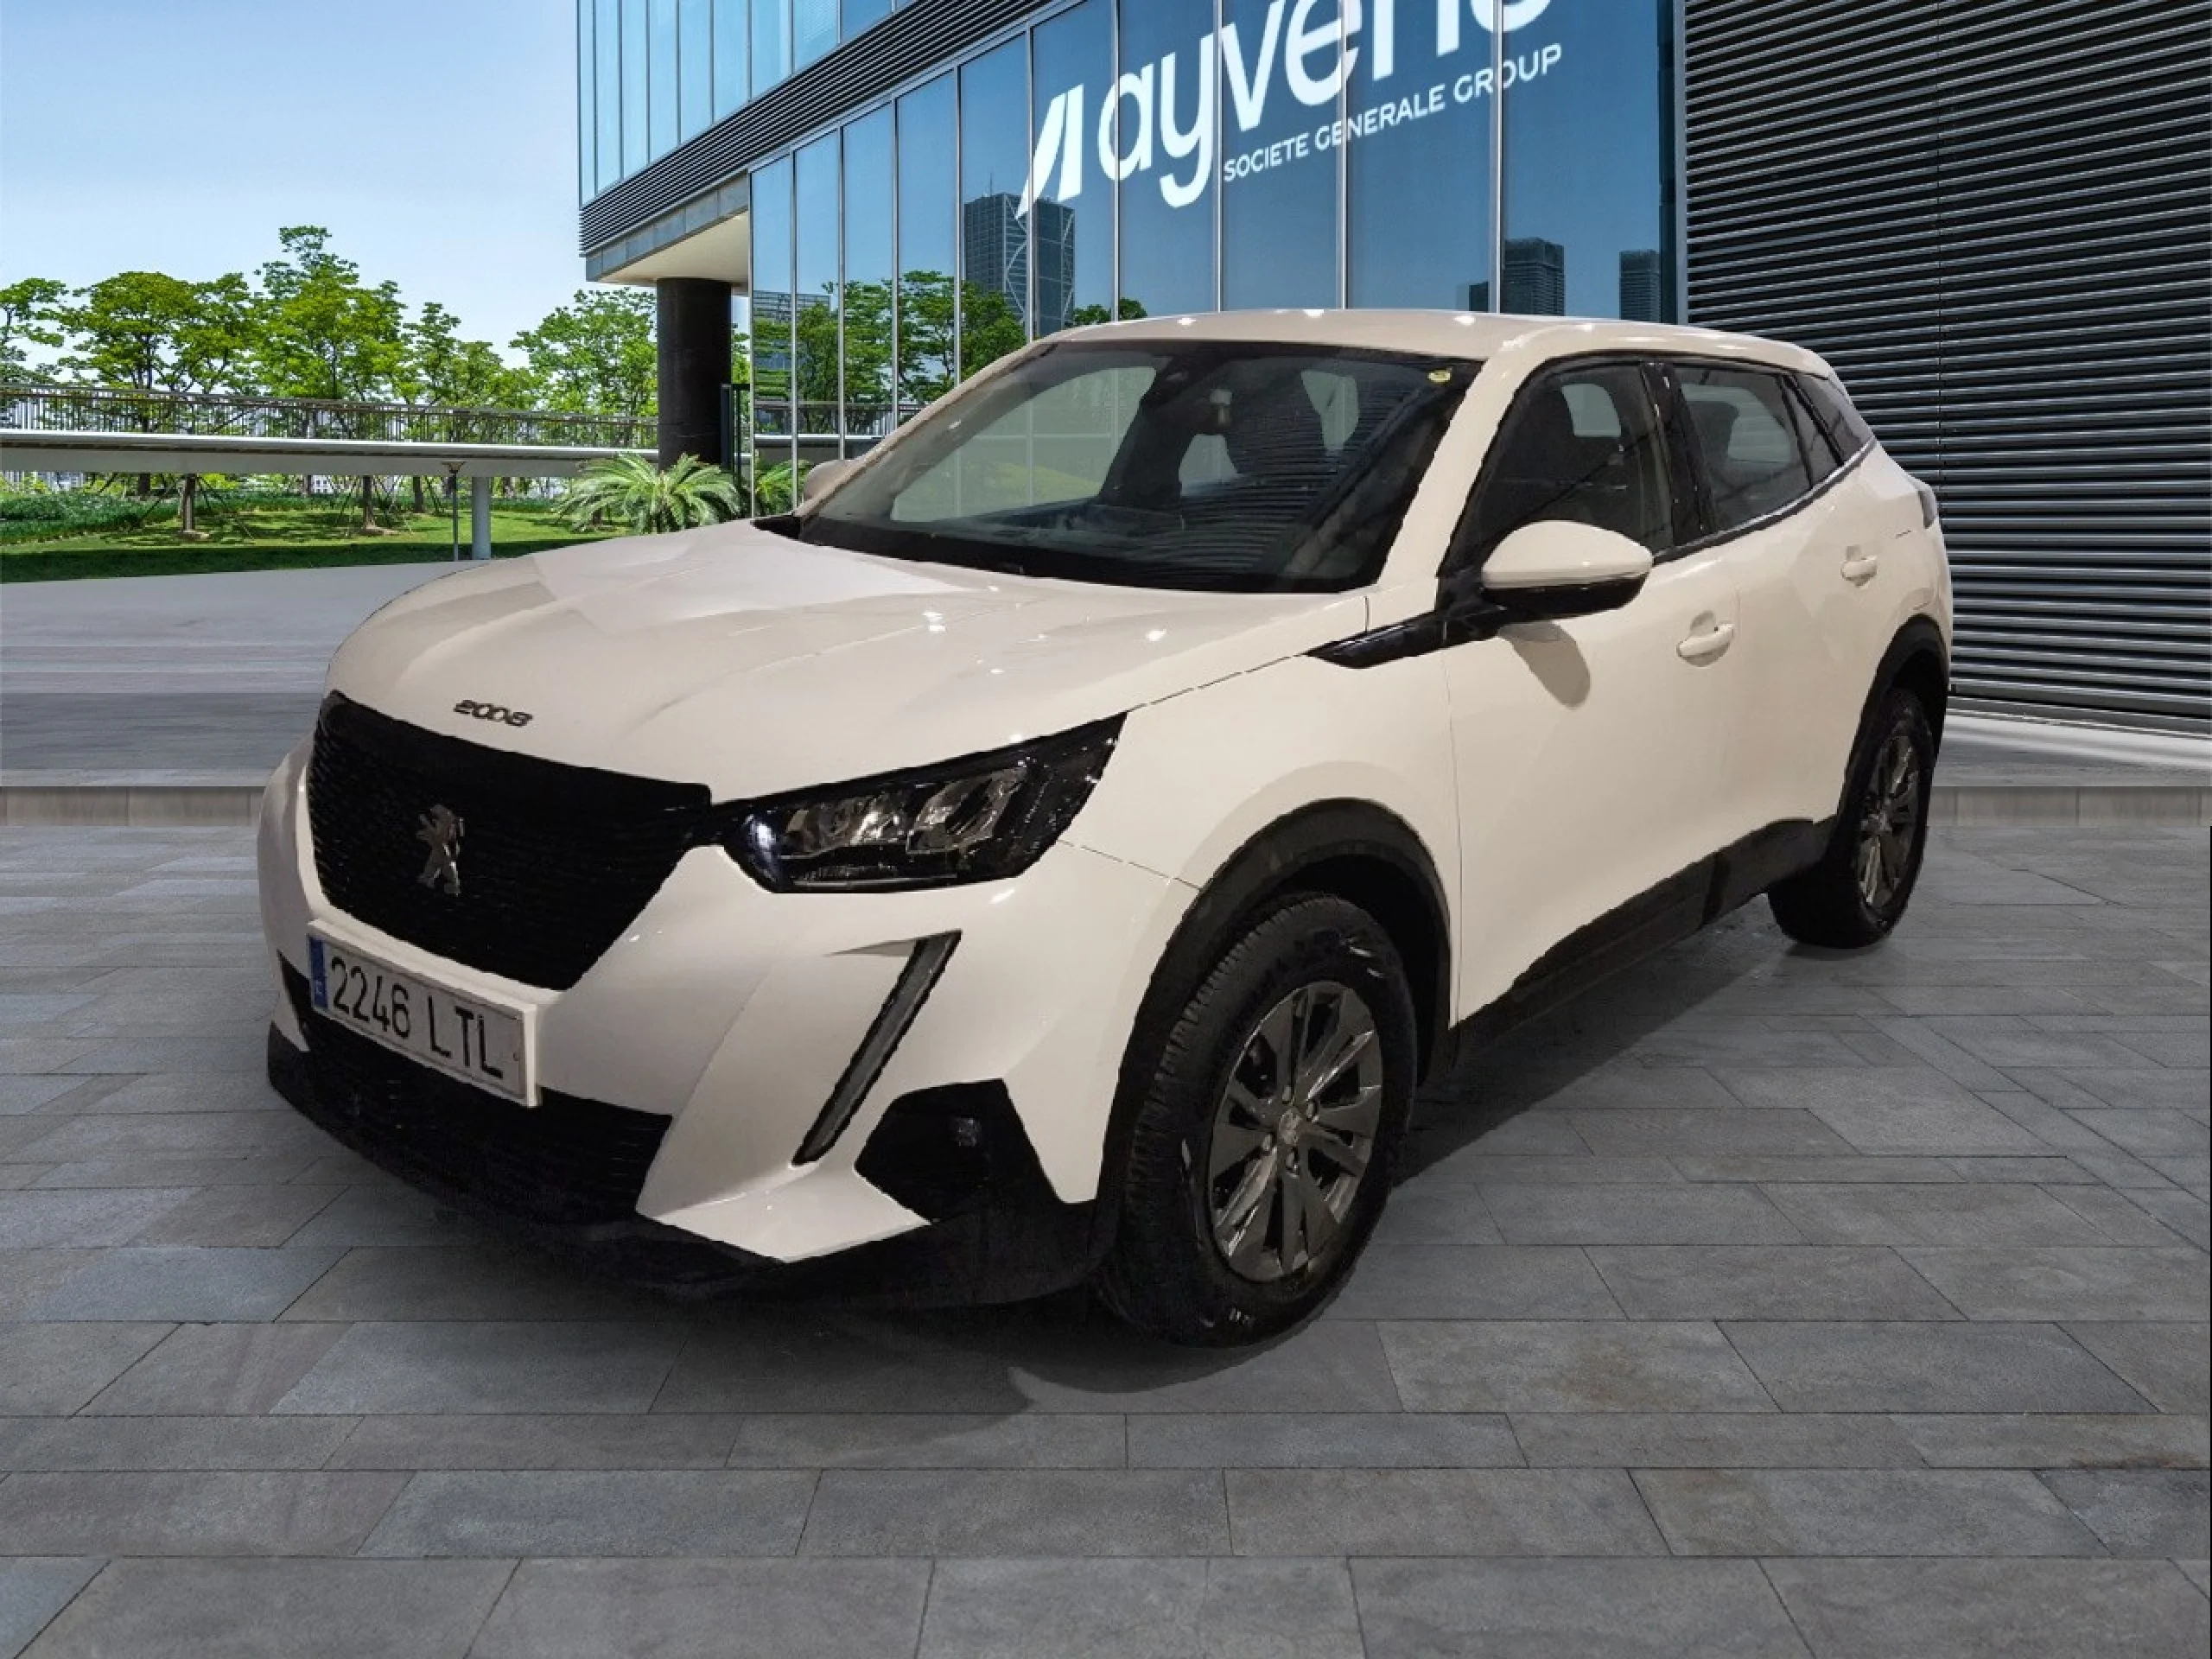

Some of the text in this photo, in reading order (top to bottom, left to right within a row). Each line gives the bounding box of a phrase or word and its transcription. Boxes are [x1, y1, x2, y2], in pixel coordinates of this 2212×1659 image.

[1097, 0, 1556, 207] ayven
[1224, 43, 1562, 182] SOCIETE GENERALE GROUP
[453, 699, 533, 728] 2008
[331, 957, 503, 1079] 2246 LTL
